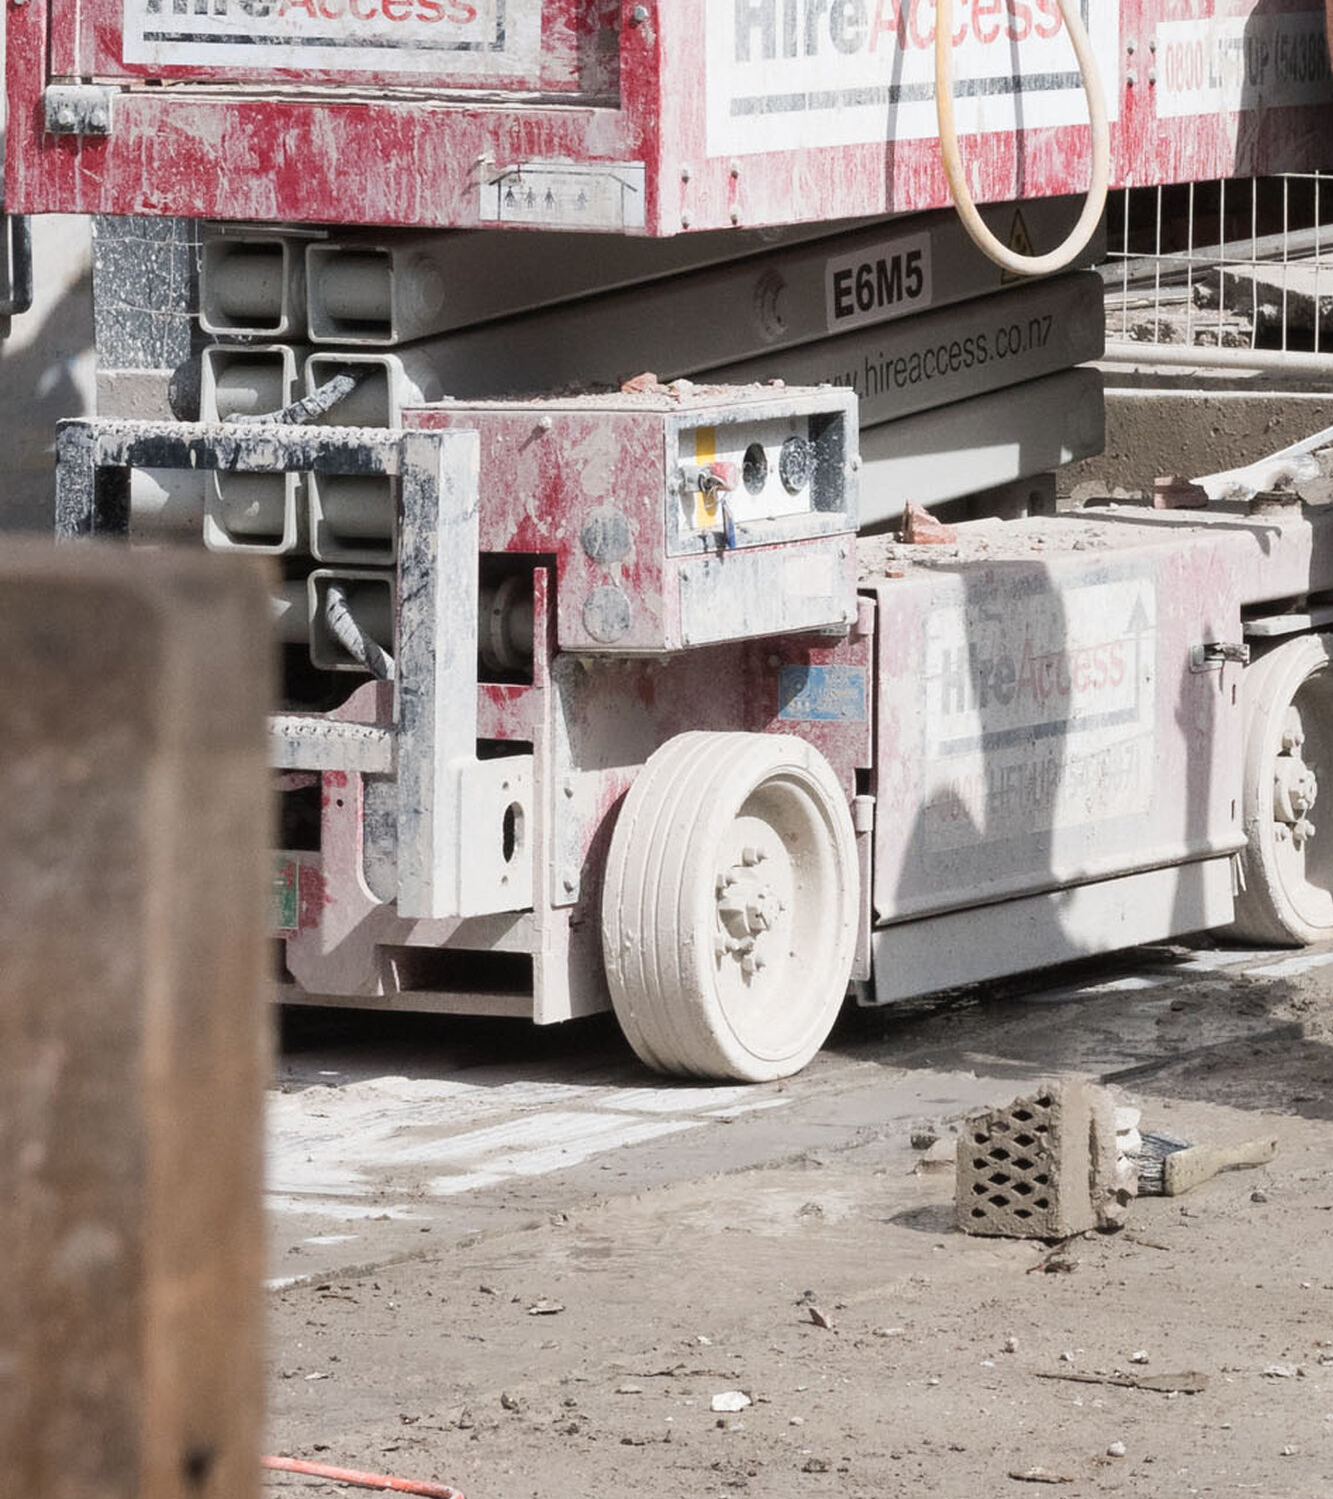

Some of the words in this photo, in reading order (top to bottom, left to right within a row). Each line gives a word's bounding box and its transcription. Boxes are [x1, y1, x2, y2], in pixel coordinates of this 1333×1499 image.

[1165, 39, 1204, 93] 0800
[1249, 36, 1270, 87] UP
[833, 250, 924, 320] E6M5
